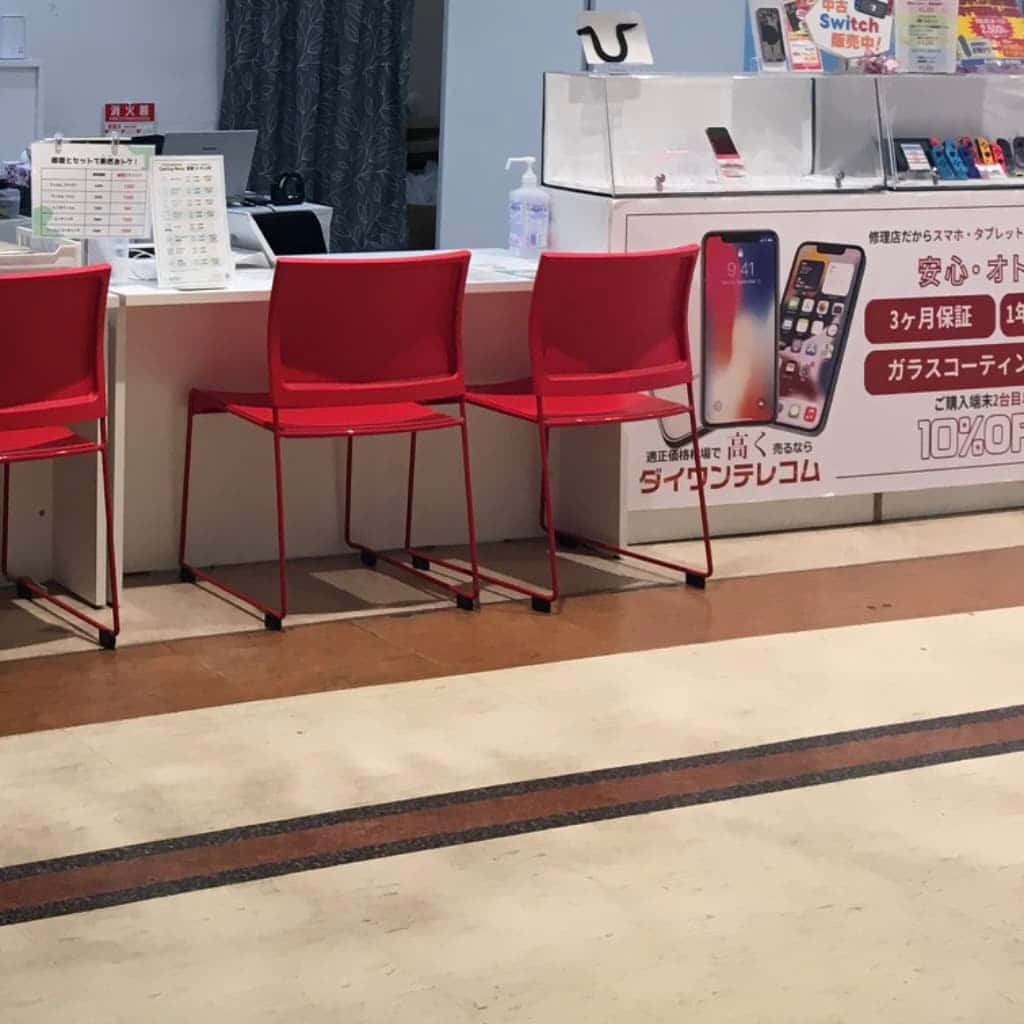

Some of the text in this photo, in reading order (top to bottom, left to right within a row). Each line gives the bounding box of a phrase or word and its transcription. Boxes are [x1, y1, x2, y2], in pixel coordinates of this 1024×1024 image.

[820, 14, 879, 33] Switch
[869, 227, 1024, 245] 修理店だからスマホ・タブレット
[935, 391, 1024, 411] ご購入端末2台目
[728, 431, 766, 461] 高く
[772, 441, 813, 455] 売るなら
[639, 459, 820, 494] ダイワンテレコム
